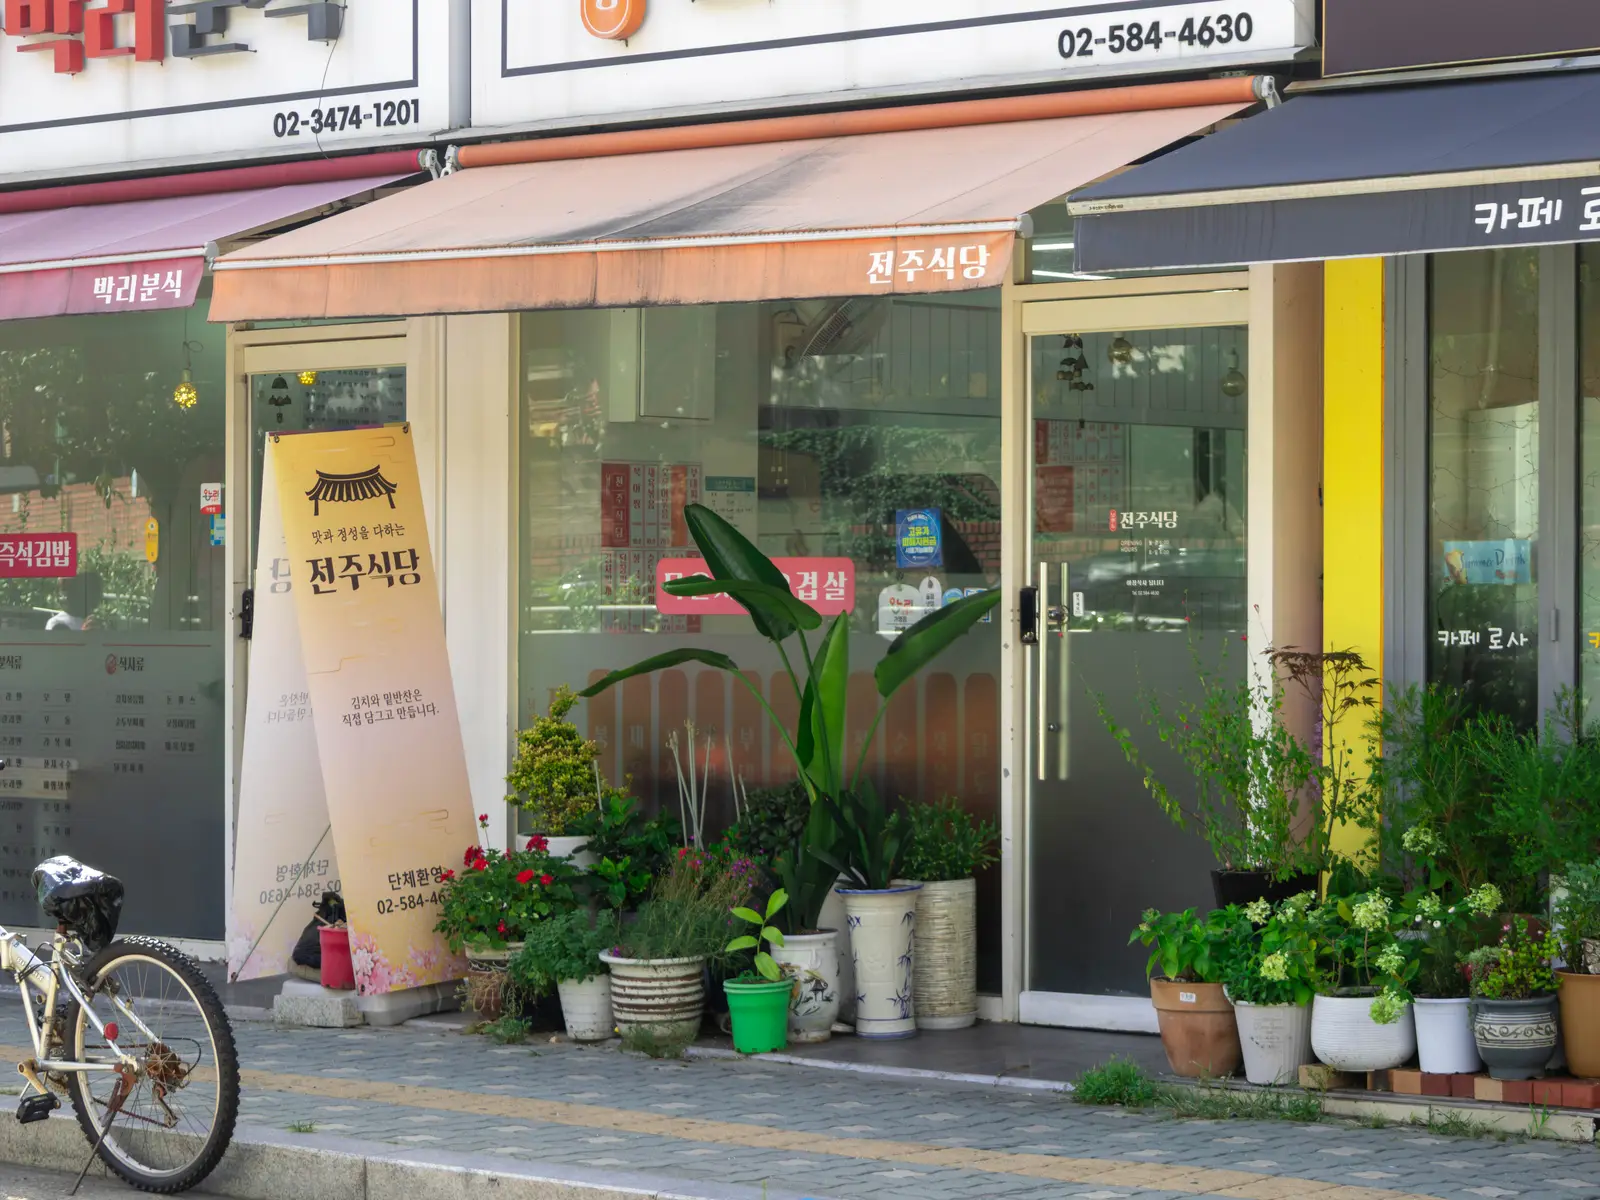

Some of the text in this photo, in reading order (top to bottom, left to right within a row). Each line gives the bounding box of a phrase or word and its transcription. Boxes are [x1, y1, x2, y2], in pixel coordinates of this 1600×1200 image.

[1057, 12, 1254, 59] 02-584-4630
[273, 98, 419, 138] 02-3474-1201
[1474, 196, 1563, 235] 카페
[867, 245, 990, 285] 전주식당
[93, 269, 183, 305] 박리분식
[1120, 510, 1179, 529] 전주식당
[312, 523, 405, 545] 맛과 정성을 다하는
[0, 540, 72, 568] 즉석김밥
[306, 548, 421, 595] 전주식당
[1438, 627, 1528, 650] 카페 로사
[351, 688, 423, 710] 김치와 밑반찬은
[342, 702, 440, 727] 직접 담그고 만듭니다.
[387, 865, 444, 891] 단체환영
